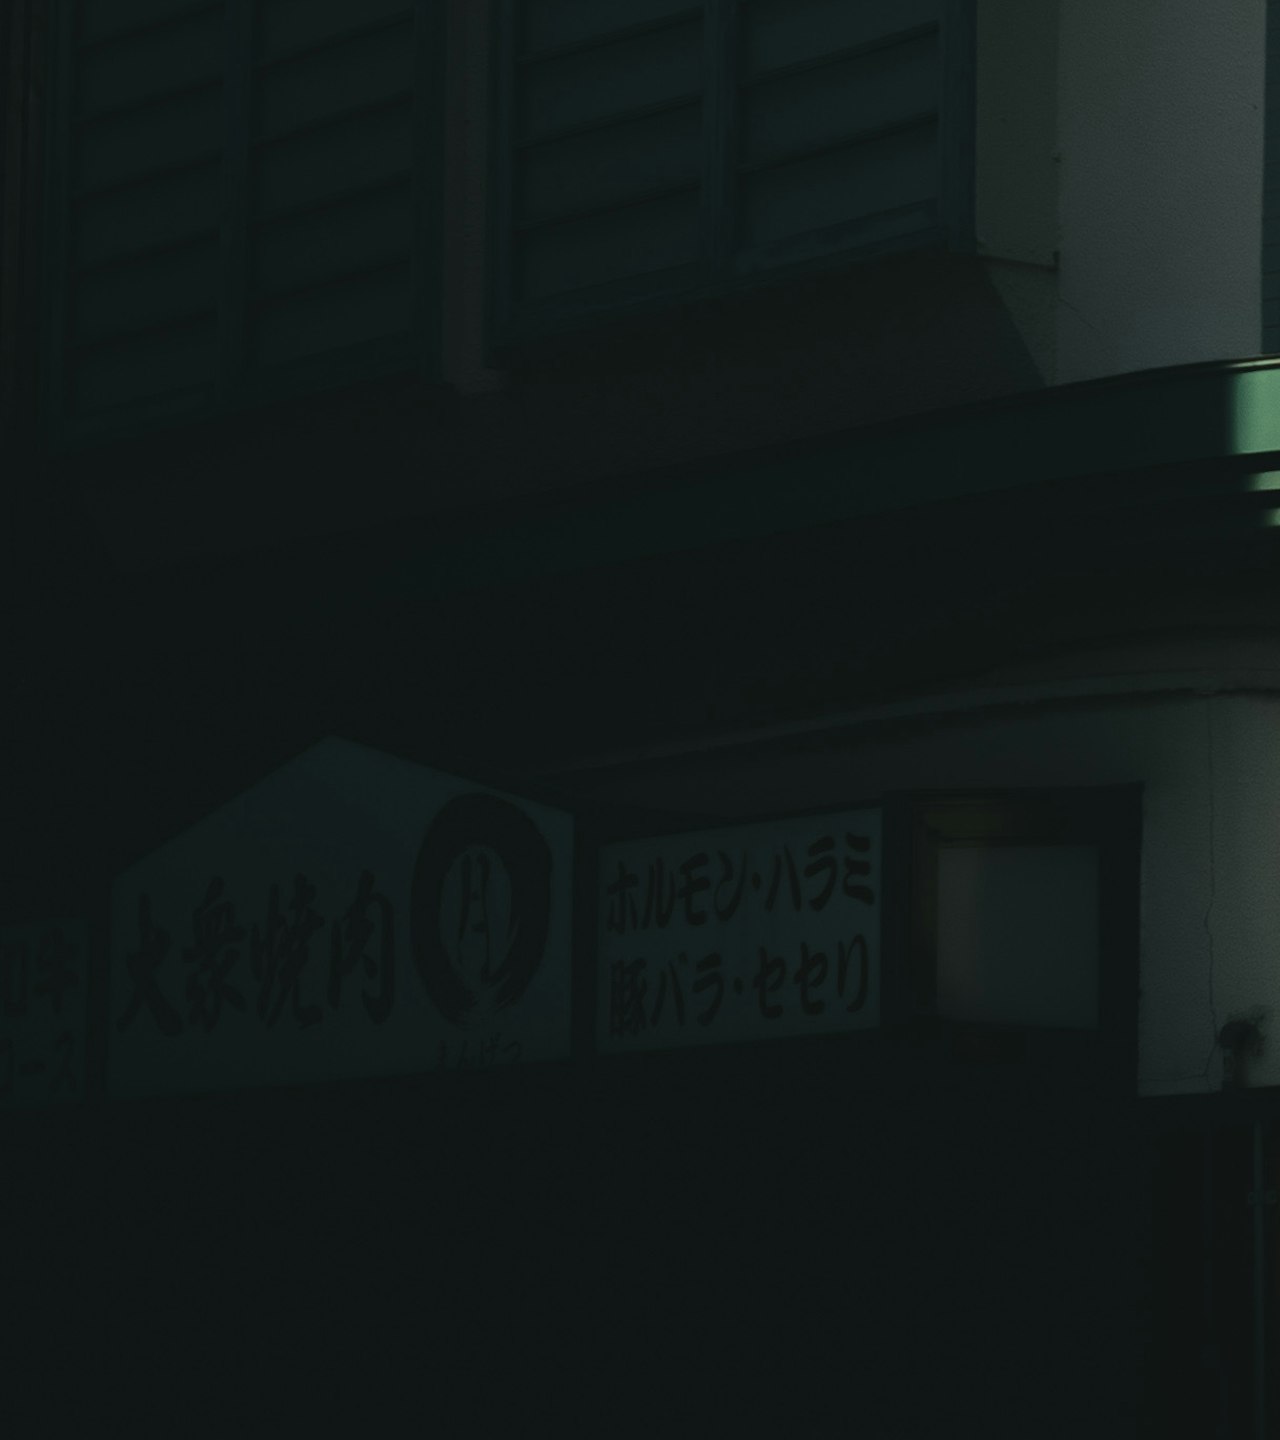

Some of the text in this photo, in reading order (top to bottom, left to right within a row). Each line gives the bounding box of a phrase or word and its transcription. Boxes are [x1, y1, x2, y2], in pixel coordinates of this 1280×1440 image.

[606, 832, 874, 935] ホルモン・ハラミ
[116, 870, 396, 1038] 大衆焼肉
[608, 934, 869, 1038] 豚バラ・セセリ
